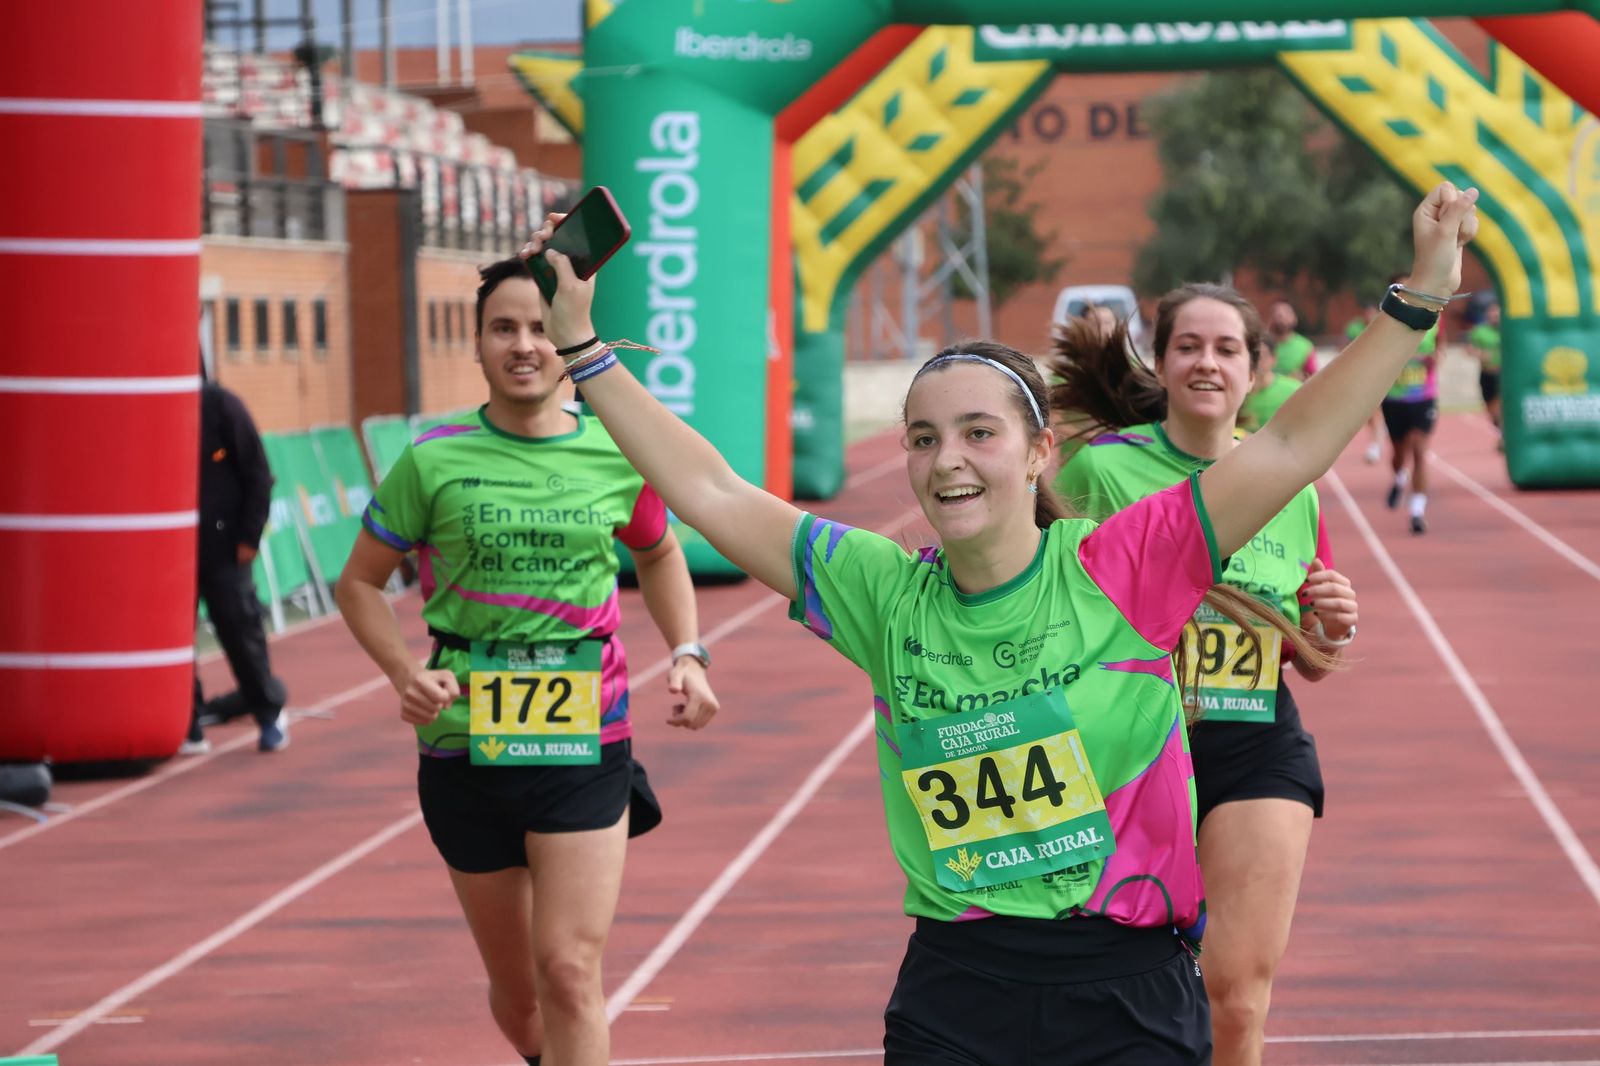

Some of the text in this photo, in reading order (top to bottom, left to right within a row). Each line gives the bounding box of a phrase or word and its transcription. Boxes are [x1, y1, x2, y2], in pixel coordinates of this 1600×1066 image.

[674, 26, 813, 61] Iberdrola
[479, 502, 613, 526] En marcha
[480, 528, 566, 549] contra
[481, 551, 504, 572] el
[481, 676, 573, 724] 172
[912, 680, 947, 711] En
[1222, 697, 1269, 712] RURAL
[508, 742, 593, 756] CAJA RURAL
[941, 723, 1021, 752] CAJA RURAL
[957, 743, 989, 757] ZAMORA
[918, 744, 1067, 830] 344
[986, 827, 1105, 869] CAJA RURAL
